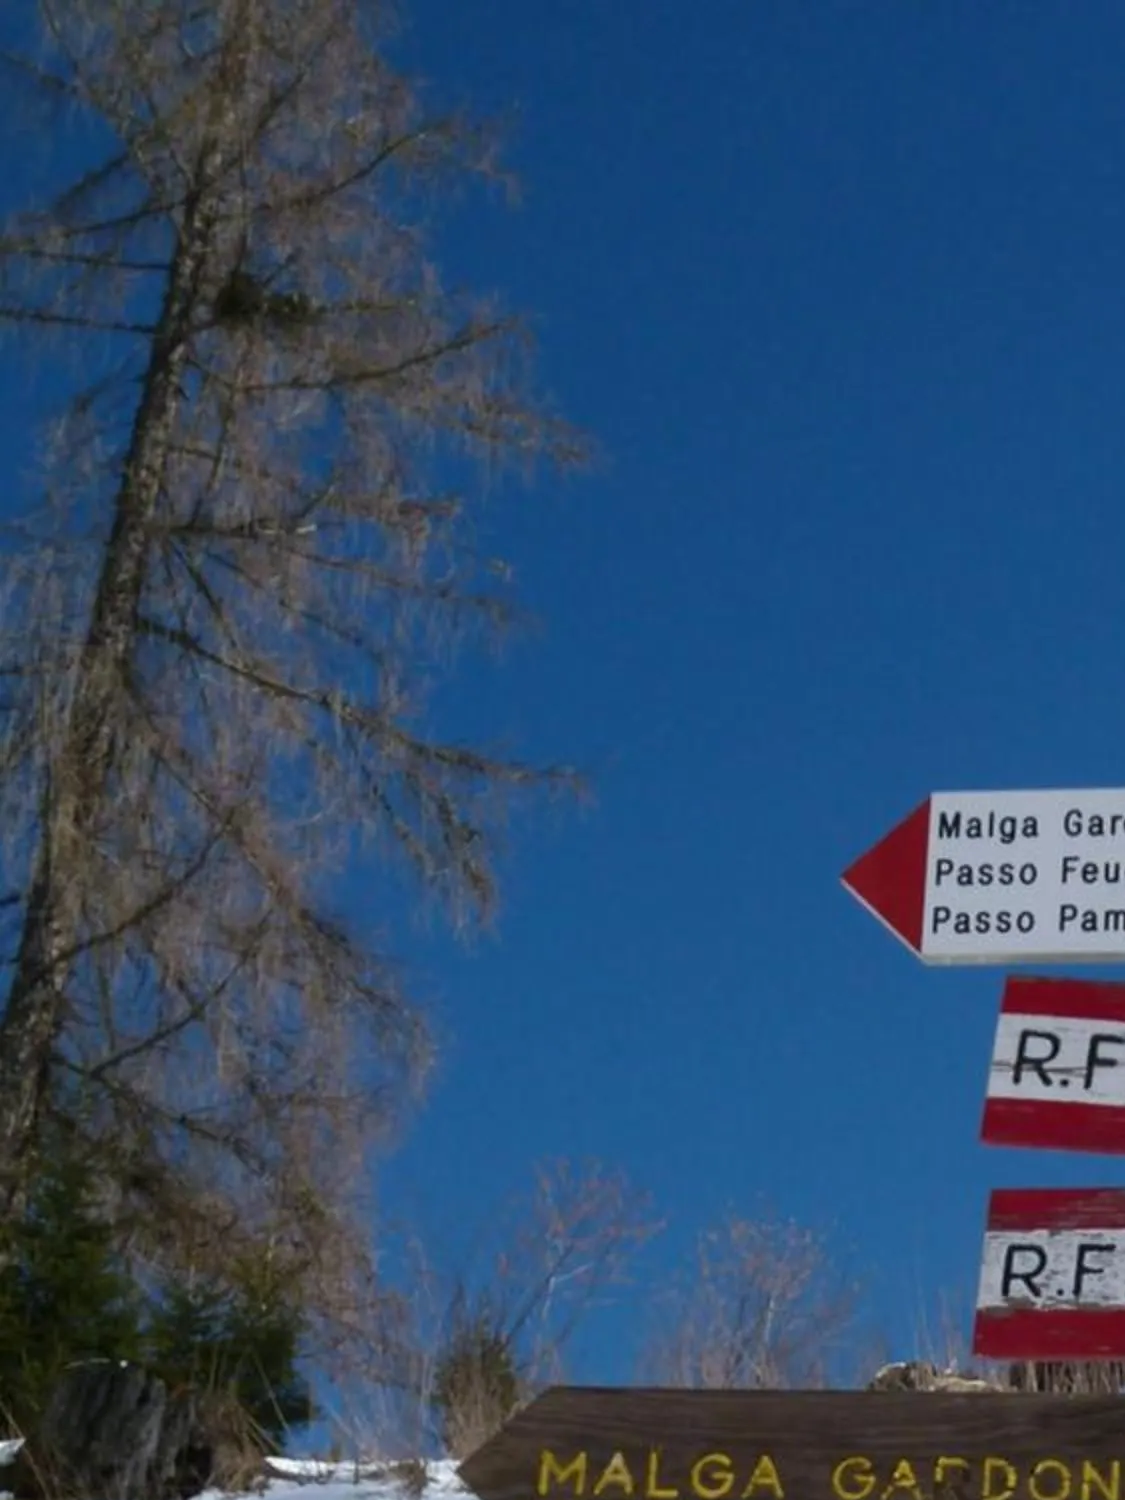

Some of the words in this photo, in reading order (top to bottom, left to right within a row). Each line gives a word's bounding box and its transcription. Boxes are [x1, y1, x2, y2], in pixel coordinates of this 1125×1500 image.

[938, 811, 1039, 842] Malga
[934, 858, 1038, 886] Passo
[931, 906, 1036, 934] Passo
[535, 1446, 785, 1500] MALGA
